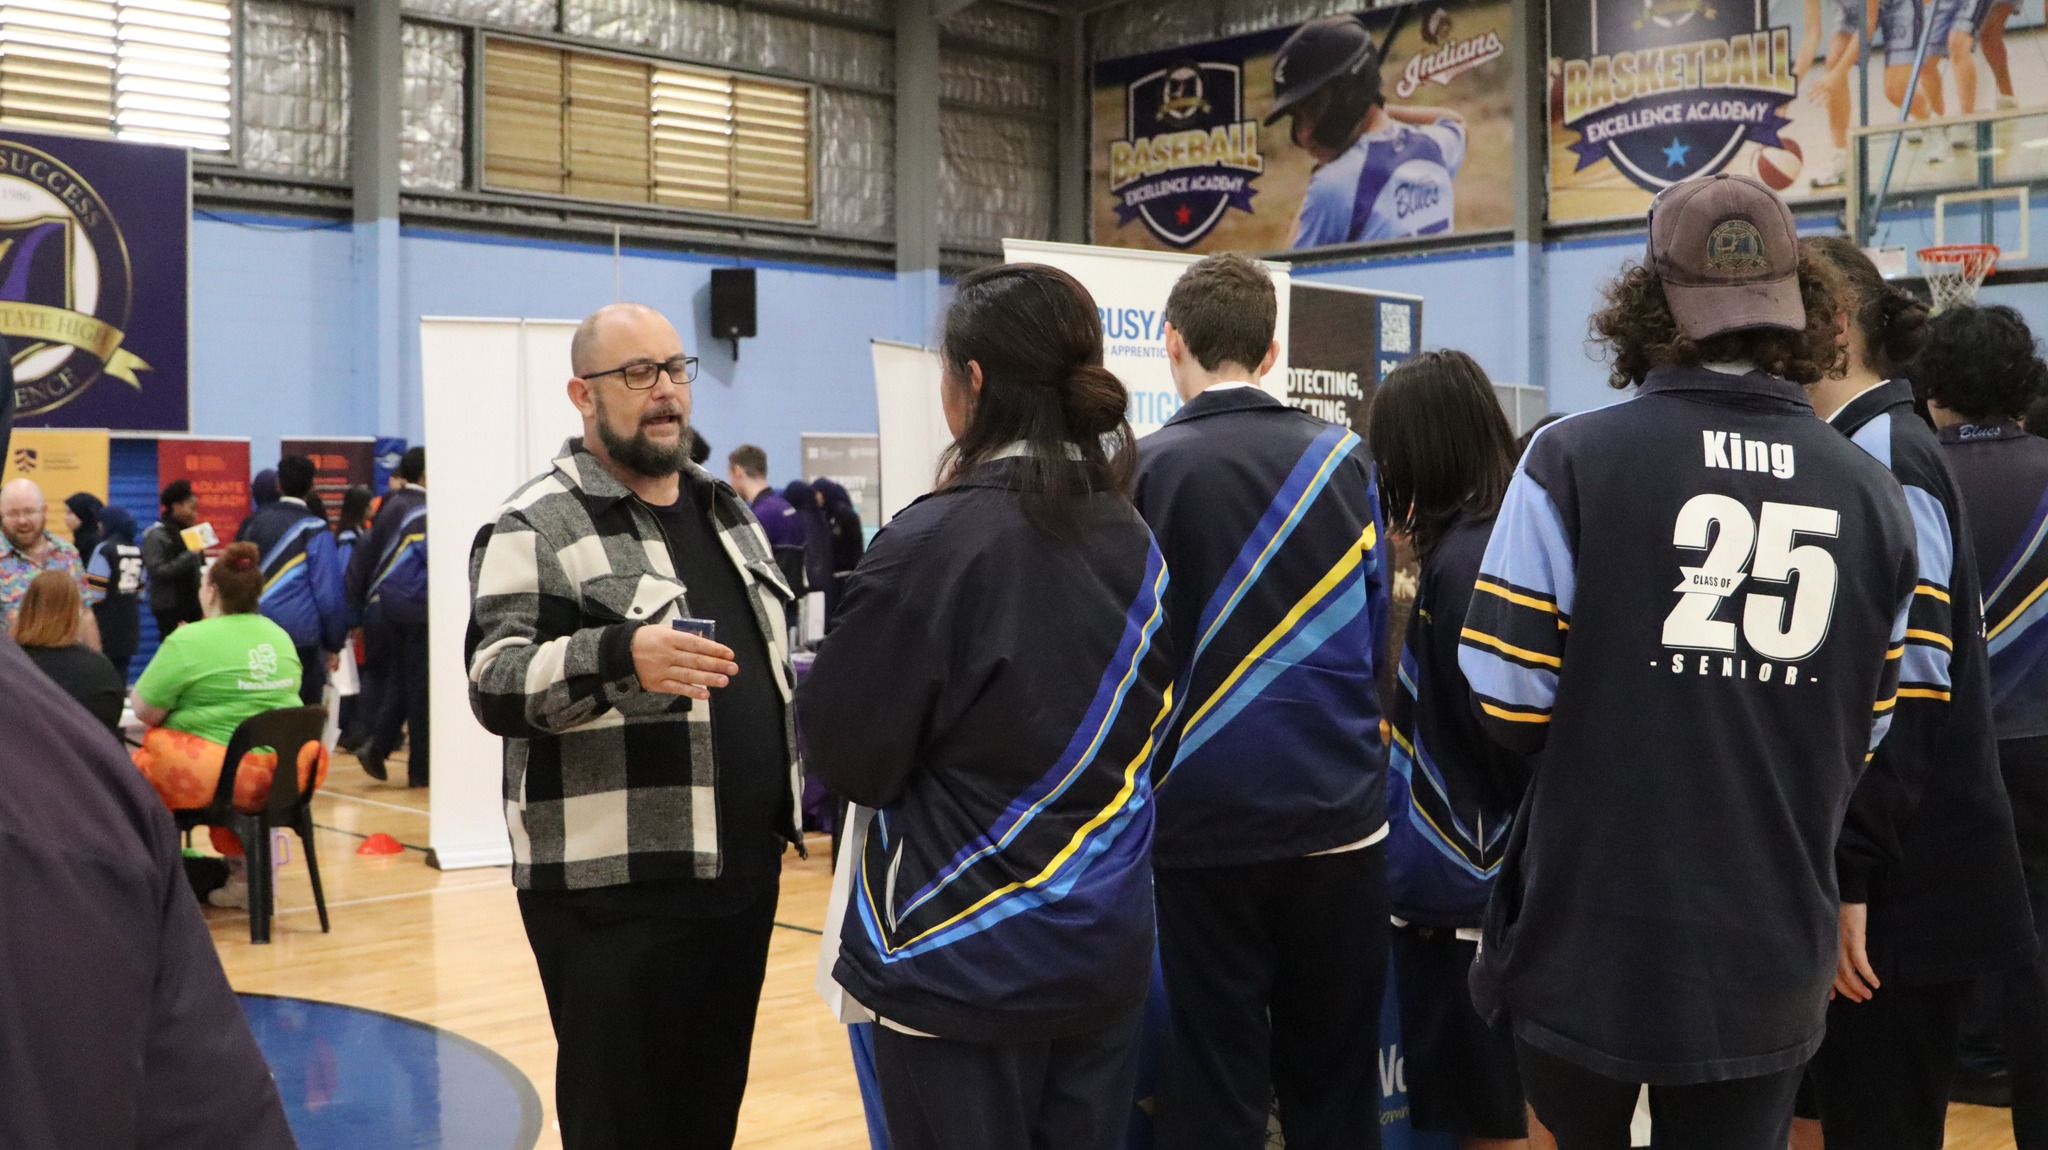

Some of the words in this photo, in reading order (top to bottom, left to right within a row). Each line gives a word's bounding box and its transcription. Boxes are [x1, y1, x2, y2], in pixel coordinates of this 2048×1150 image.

[1396, 30, 1503, 98] Indians
[1564, 28, 1796, 125] BASKETBALL
[1586, 103, 1682, 143] EXCELLENCE
[1686, 101, 1768, 122] ACADEMY
[1111, 121, 1263, 191] BASEBALL
[1125, 176, 1188, 206] EXCELLENCE
[1190, 175, 1244, 193] ACADEMY
[1394, 181, 1439, 219] Blues
[0, 308, 52, 330] TATE
[1111, 345, 1169, 359] APPRENTIC
[1959, 424, 2000, 440] Blues
[1702, 430, 1795, 479] King
[1661, 493, 1841, 661] 25
[1693, 574, 1719, 588] CLASS
[1720, 577, 1731, 588] OF
